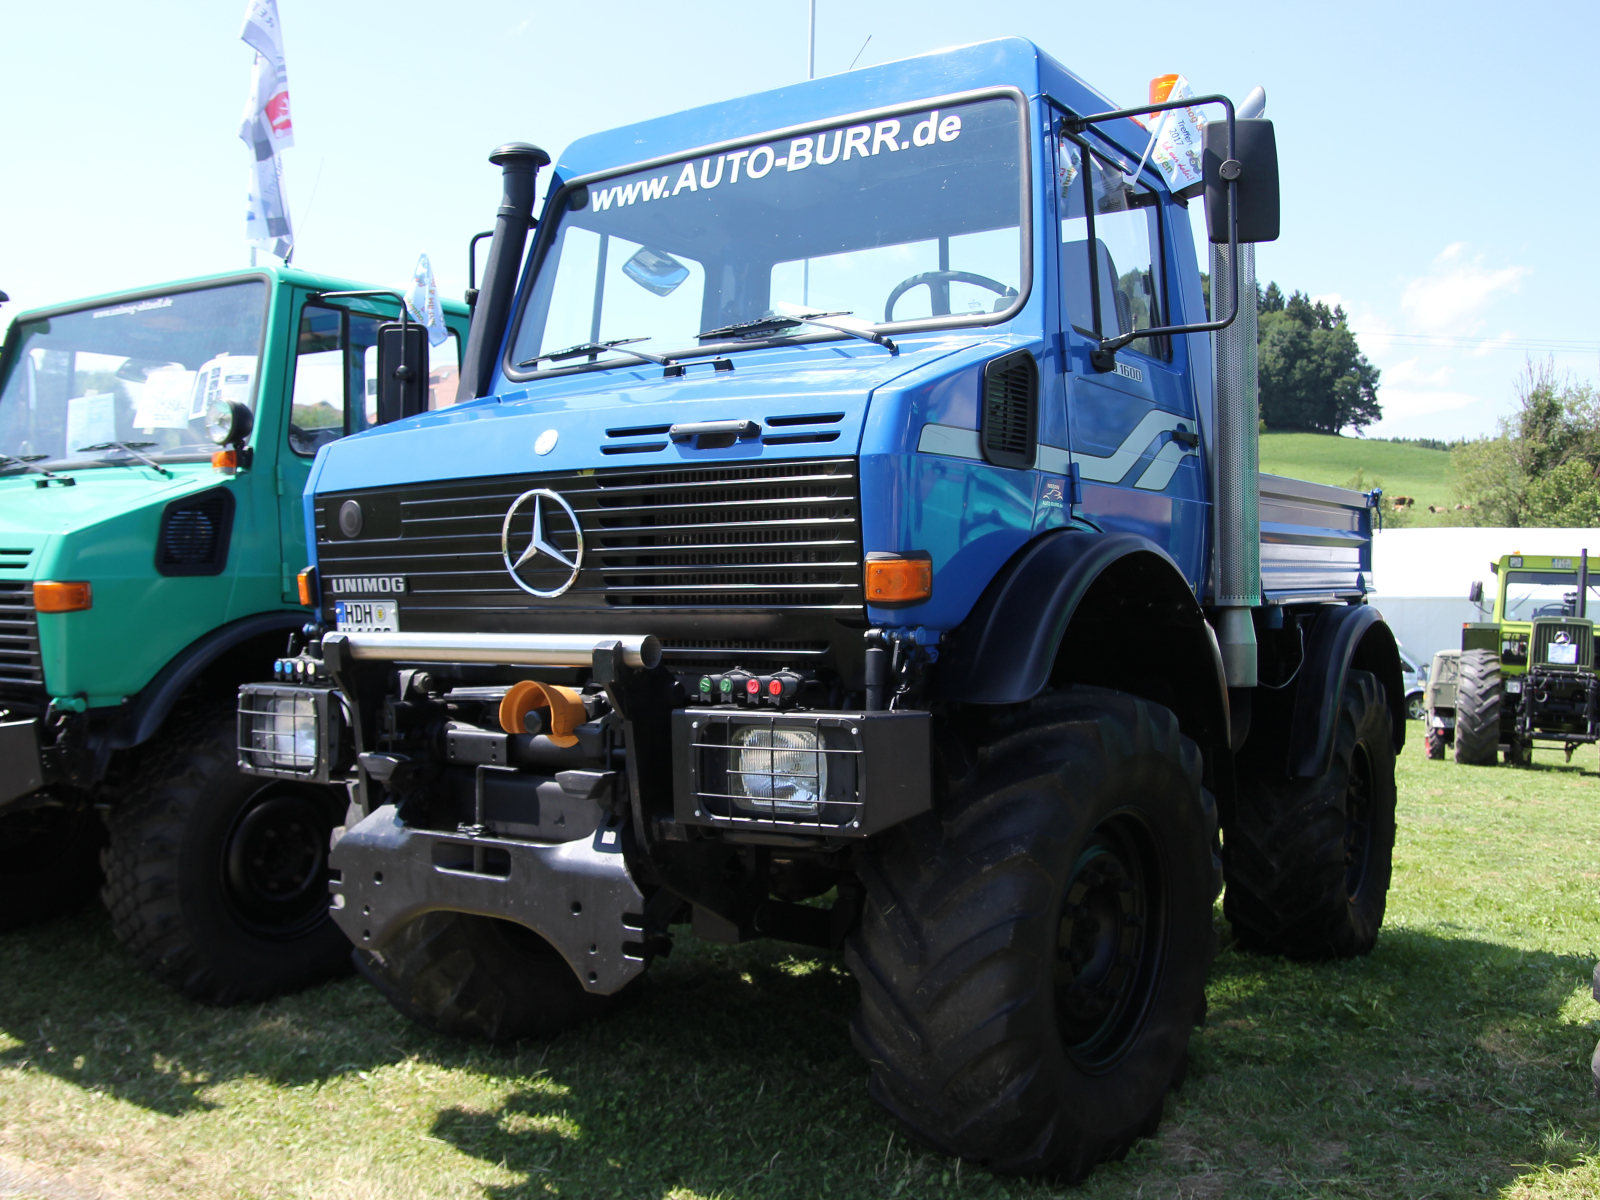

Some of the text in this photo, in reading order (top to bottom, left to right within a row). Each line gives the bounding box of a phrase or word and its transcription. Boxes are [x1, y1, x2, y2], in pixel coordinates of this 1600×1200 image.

[1169, 128, 1185, 146] 2017
[1177, 119, 1193, 146] Treffen
[590, 110, 962, 213] www.AUTO-BURR.de
[1119, 364, 1142, 381] 1600
[332, 577, 405, 593] UNIMOG
[345, 604, 373, 624] HDH
